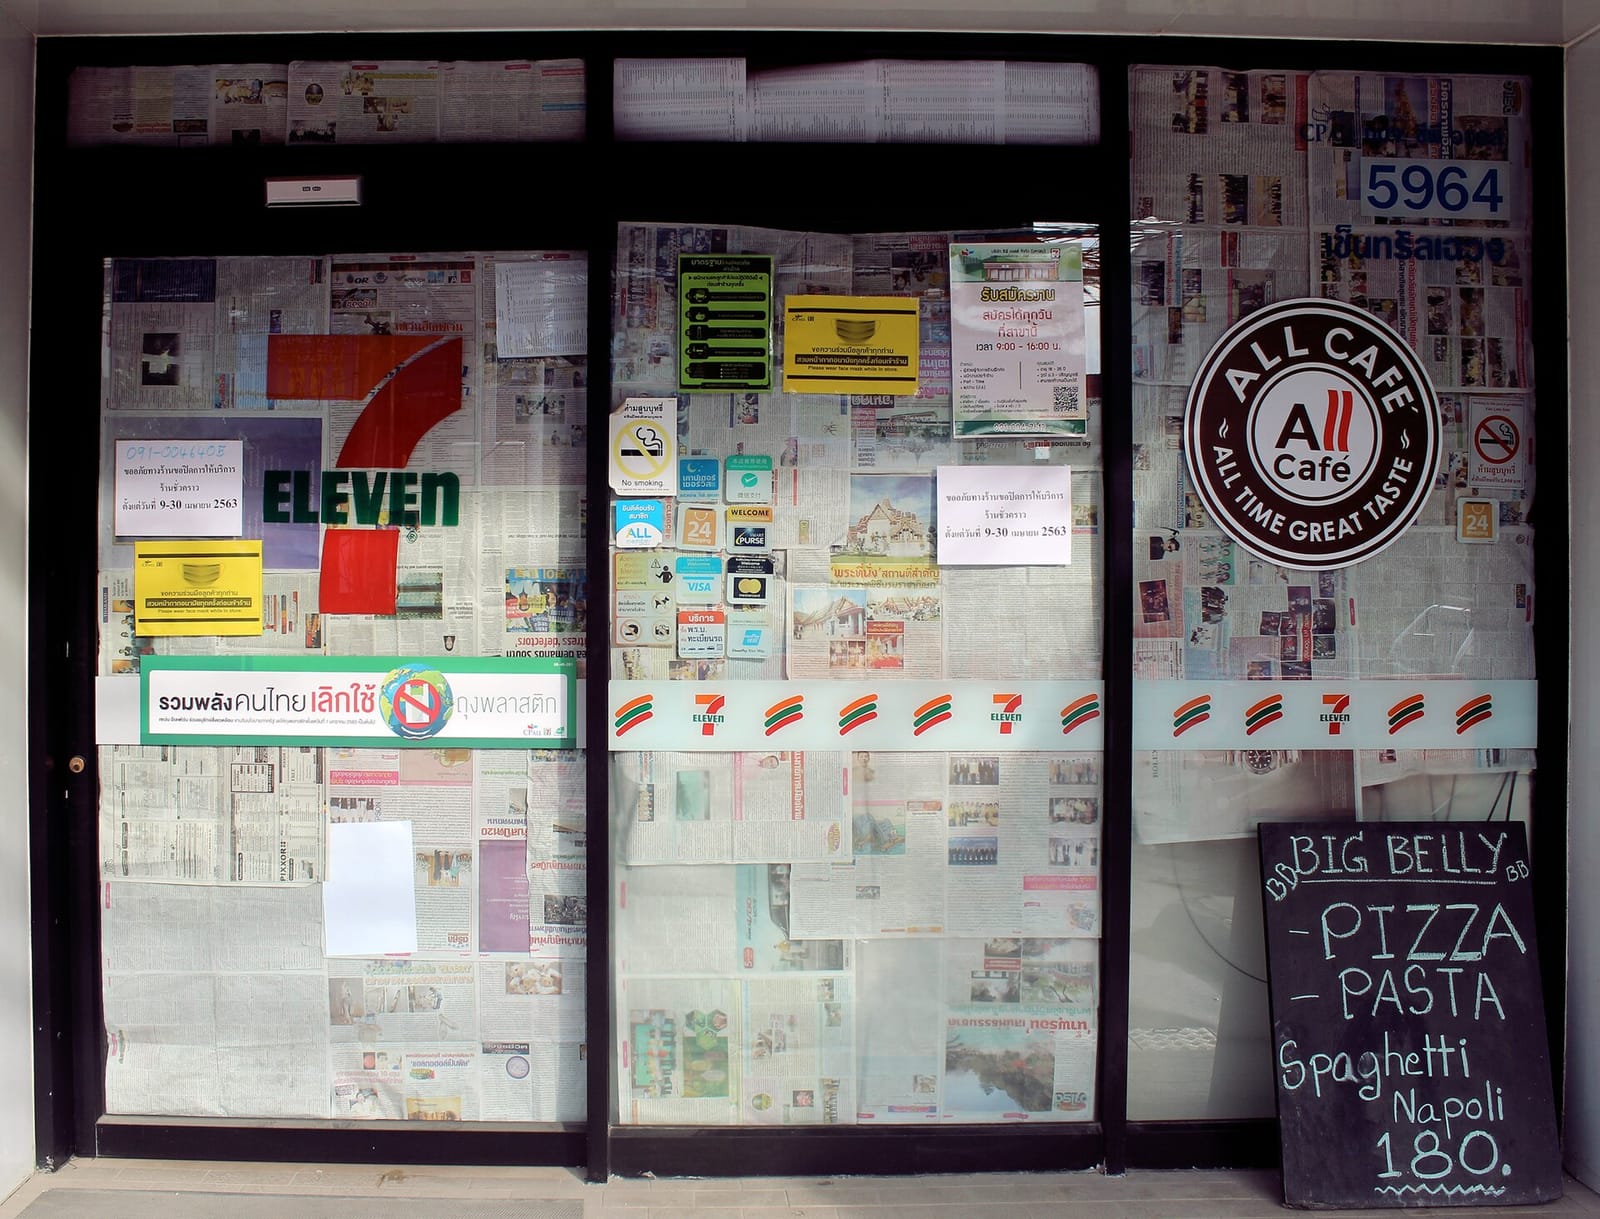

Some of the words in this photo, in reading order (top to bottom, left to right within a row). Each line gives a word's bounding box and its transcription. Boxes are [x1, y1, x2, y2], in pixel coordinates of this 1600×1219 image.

[1367, 165, 1504, 212] 5964
[980, 286, 1056, 302] รับสมัครงาน
[982, 307, 1052, 323] สมัครได้ทุกวัน
[998, 322, 1038, 338] ที่สาขานี้
[975, 343, 993, 351] เวลา
[996, 342, 1016, 351] 9:00
[1026, 342, 1049, 351] 16:00
[1052, 343, 1062, 351] น.
[1224, 325, 1310, 404] ALL
[1324, 327, 1419, 415] CAFÉ
[124, 464, 236, 475] ขออภัยทางร้านขอปิดการให้บริการ
[1273, 453, 1351, 484] Café
[1477, 462, 1516, 475] ห้ามสูบบุหรี่
[160, 481, 200, 492] ร้านชั่วคราว
[621, 479, 632, 487] No
[634, 479, 663, 488] smoking
[945, 490, 1064, 502] ขออภัยทางร้านขอปิดการให้บริการ
[1212, 445, 1233, 490] ALL
[1235, 484, 1285, 536] TIME
[1288, 510, 1364, 543] GREAT
[1362, 457, 1414, 521] TASTE
[122, 498, 157, 511] ตั้งแต่วันที่
[160, 500, 182, 510] 9-30
[185, 502, 211, 510] เมษายน
[213, 498, 238, 509] 2563
[731, 508, 769, 517] WELCOME
[984, 506, 1027, 519] ร้านชั่วคราว
[688, 521, 712, 537] 24
[1466, 515, 1489, 531] 24
[626, 527, 652, 539] ALL
[945, 525, 981, 538] ตั้งแต่วันที่
[984, 527, 1008, 538] 9-30
[1011, 529, 1039, 538] เมษายน
[1041, 525, 1067, 537] 2563
[739, 536, 765, 545] PURSE
[688, 582, 711, 592] VISA
[688, 613, 715, 623] บริการ
[687, 634, 723, 643] ทะเบียนรถ
[159, 692, 233, 711] รวมพลัง
[235, 687, 306, 712] คนไทย
[311, 682, 376, 714] เลิกใช้
[457, 693, 557, 720] ถุงพลาสติก
[1290, 831, 1368, 875] BIG
[1387, 831, 1508, 875] BELLY
[1506, 860, 1529, 882] BB
[1321, 902, 1527, 961] PIZZA
[1338, 964, 1505, 1020] PASTA
[1279, 1031, 1470, 1100] Spaghetti
[1393, 1080, 1504, 1139] Napoli
[1377, 1129, 1512, 1180] 180.
